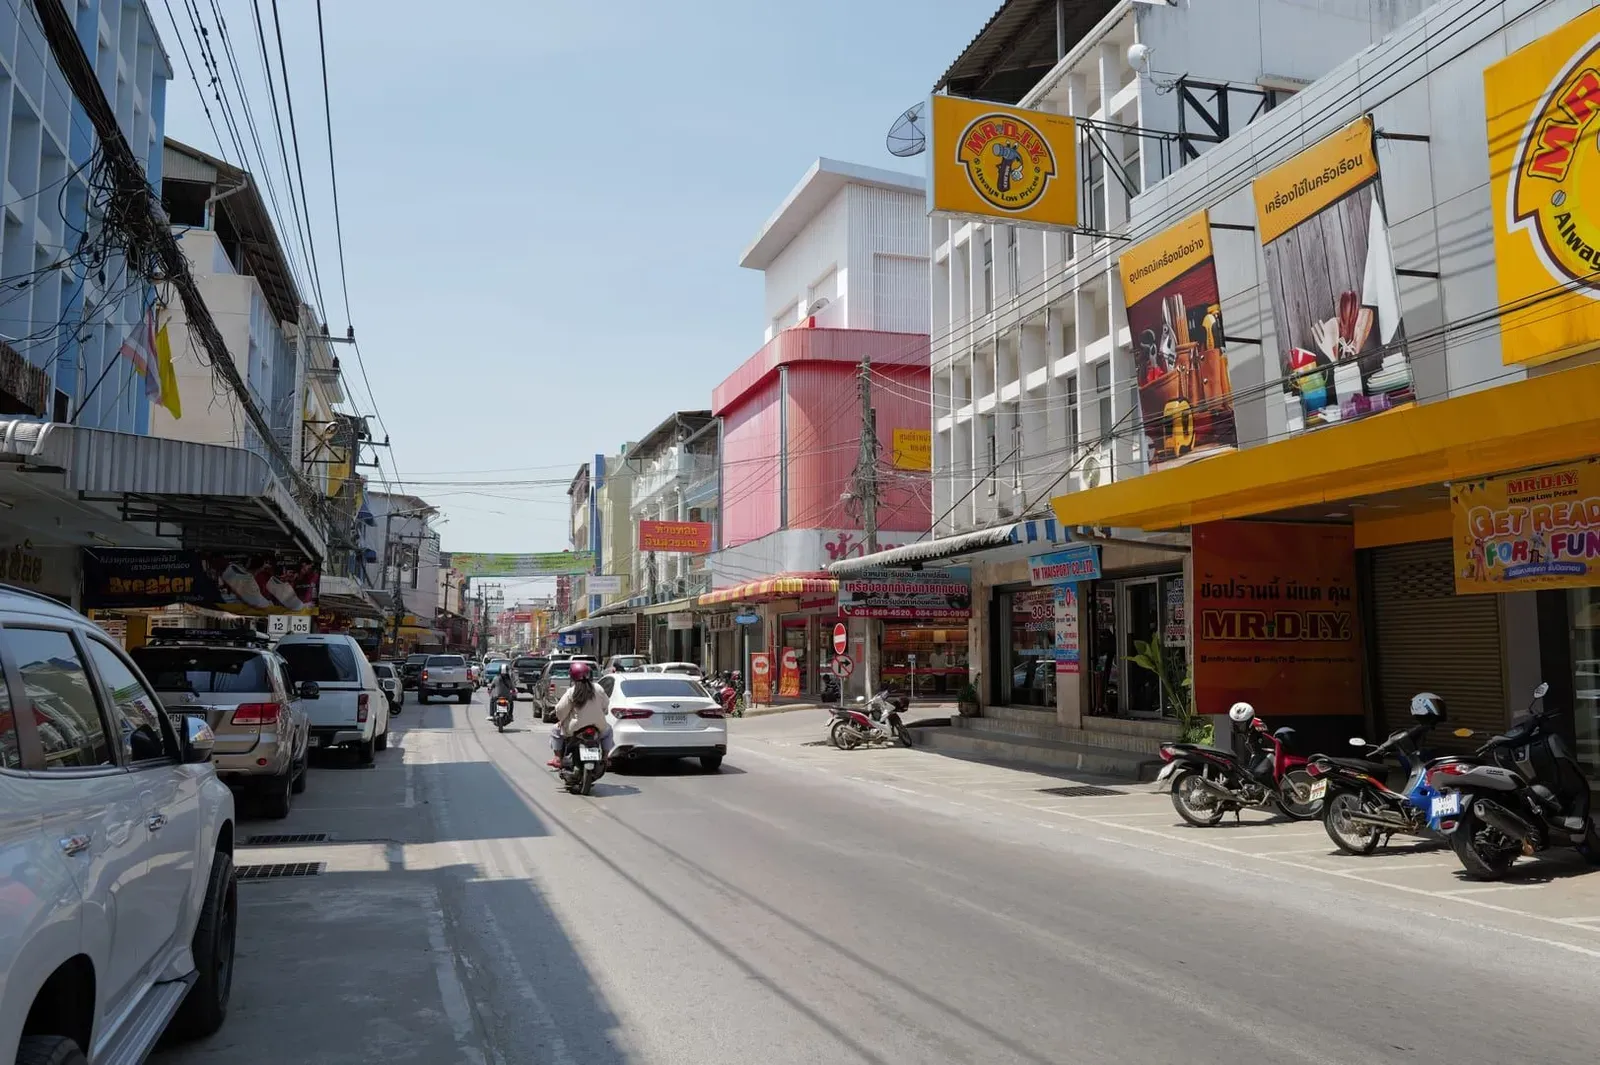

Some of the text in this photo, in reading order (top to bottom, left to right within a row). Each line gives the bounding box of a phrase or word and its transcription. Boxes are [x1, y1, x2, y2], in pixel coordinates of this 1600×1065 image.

[974, 166, 999, 198] Always
[1001, 192, 1018, 202] Low
[1019, 175, 1040, 199] Prices
[1264, 153, 1363, 214] เครื่องใช้ในครัวเรือน
[1128, 238, 1205, 284] อุปกรณ์เครื่องมือช่าง
[1508, 488, 1578, 505] Always Low Prices
[1468, 505, 1528, 541] GET
[701, 539, 707, 548] 7
[1485, 530, 1600, 568] FOR FUN
[108, 574, 196, 595] Breaker
[845, 580, 969, 596] เครื่องออกกำลังกายทุกชนิด
[1201, 573, 1280, 600] ช้อปร้านนี้
[1286, 576, 1321, 600] มีแต่
[1328, 577, 1351, 606] คุ้ม
[273, 622, 284, 631] 12
[293, 623, 308, 632] 105
